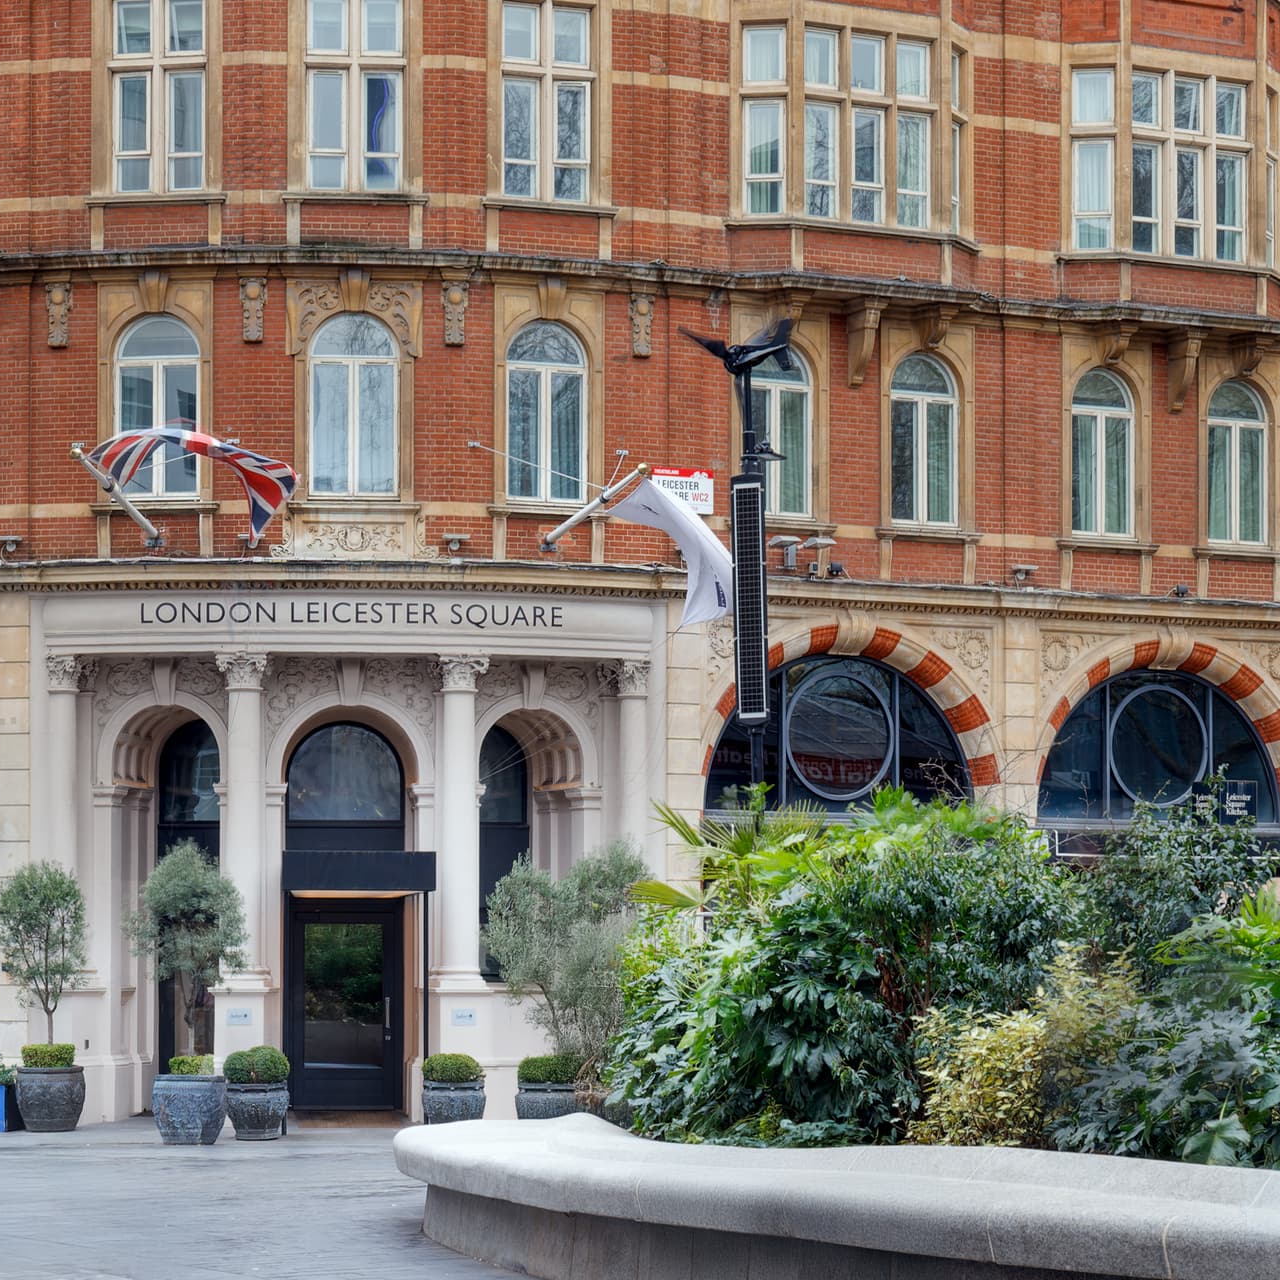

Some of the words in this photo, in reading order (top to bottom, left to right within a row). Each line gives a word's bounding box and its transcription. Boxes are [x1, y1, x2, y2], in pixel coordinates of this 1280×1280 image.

[692, 493, 709, 502] WC2
[140, 601, 277, 625] LONDON
[290, 601, 439, 625] LEICESTER
[450, 603, 563, 628] SQUARE
